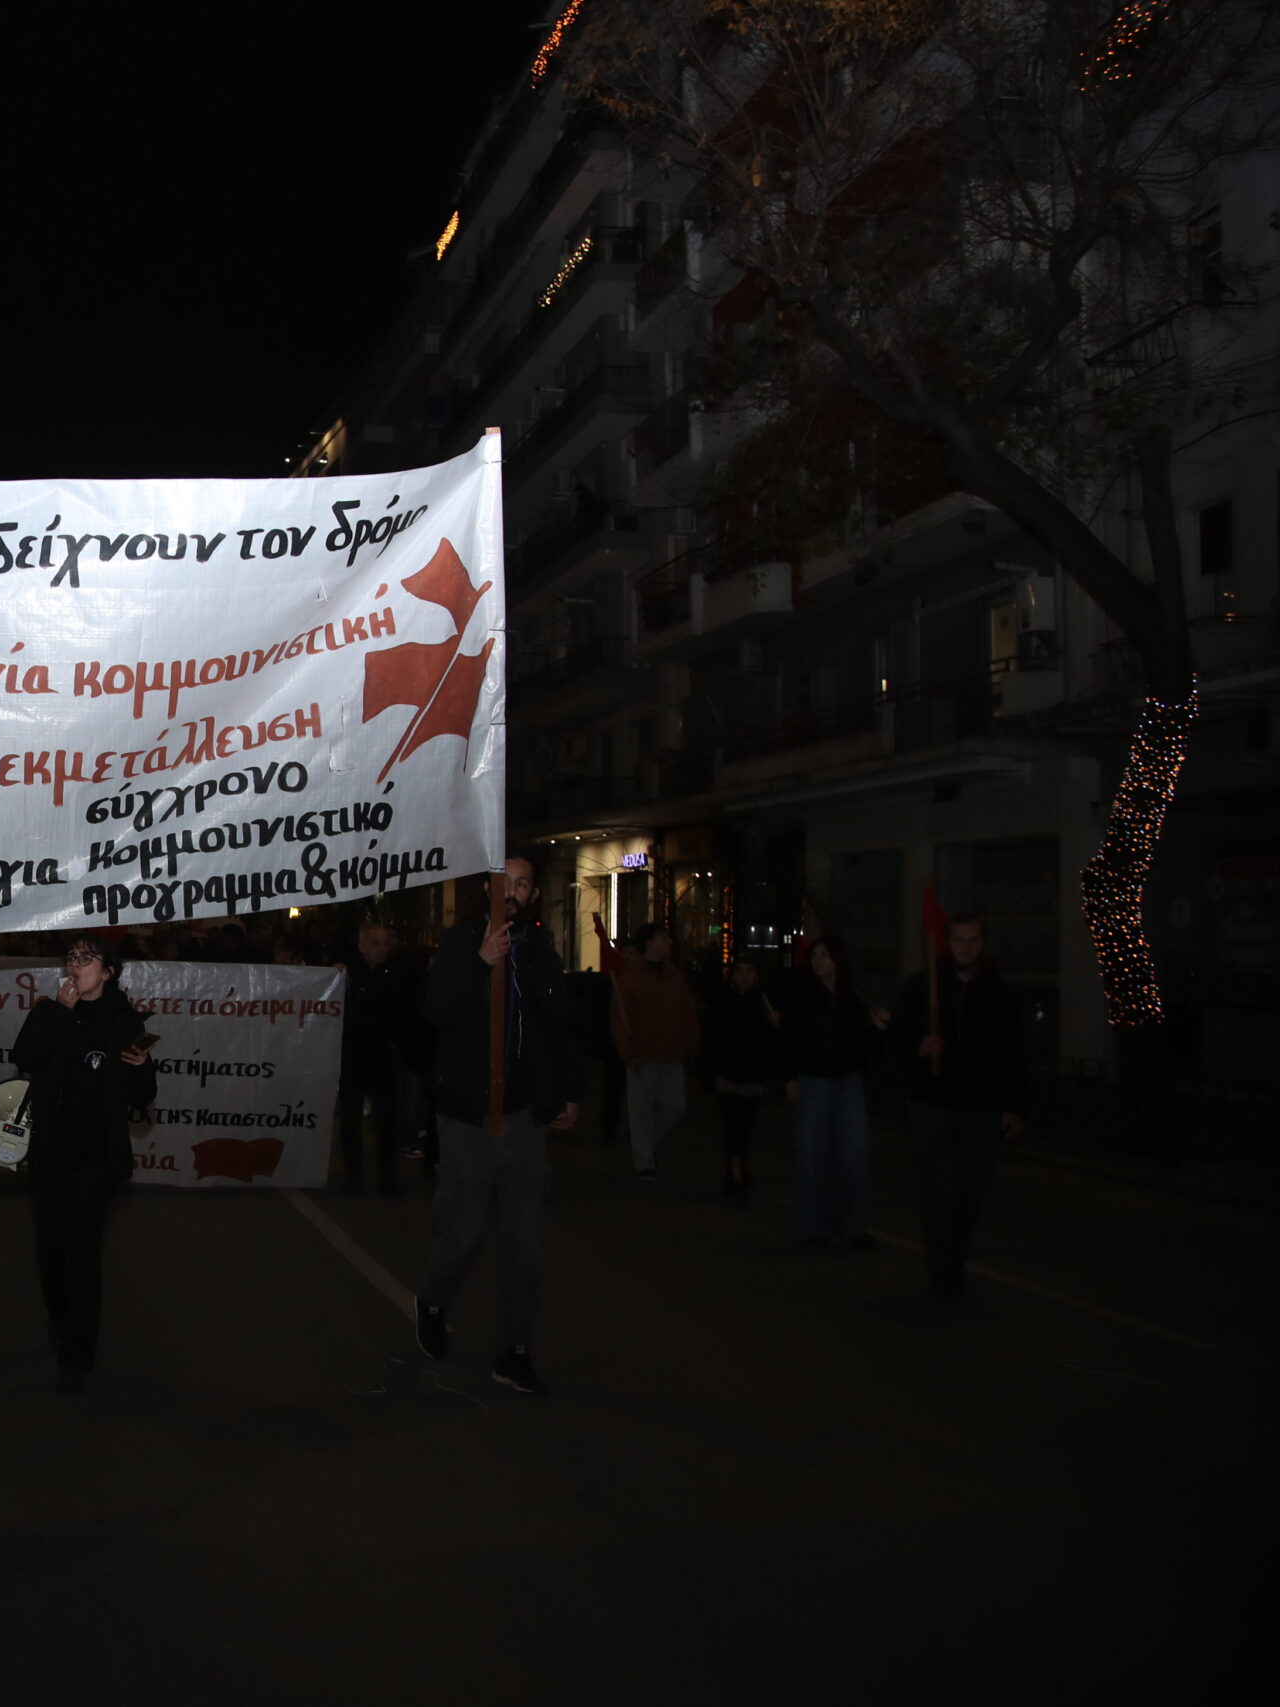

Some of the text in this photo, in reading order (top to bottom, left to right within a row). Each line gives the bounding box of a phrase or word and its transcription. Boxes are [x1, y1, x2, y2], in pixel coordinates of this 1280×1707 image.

[237, 525, 317, 562] τον
[325, 494, 428, 568] δρόμο
[73, 583, 397, 719] κομμουνιστική
[85, 761, 309, 832] σύγχρονο
[88, 780, 394, 880] κομμουνιστικό
[188, 998, 217, 1016] τα
[218, 986, 296, 1025] όνειρα
[299, 998, 342, 1029] μας
[153, 1049, 277, 1089] στήματος
[154, 1107, 194, 1126] της
[195, 1100, 318, 1129] καταστολής
